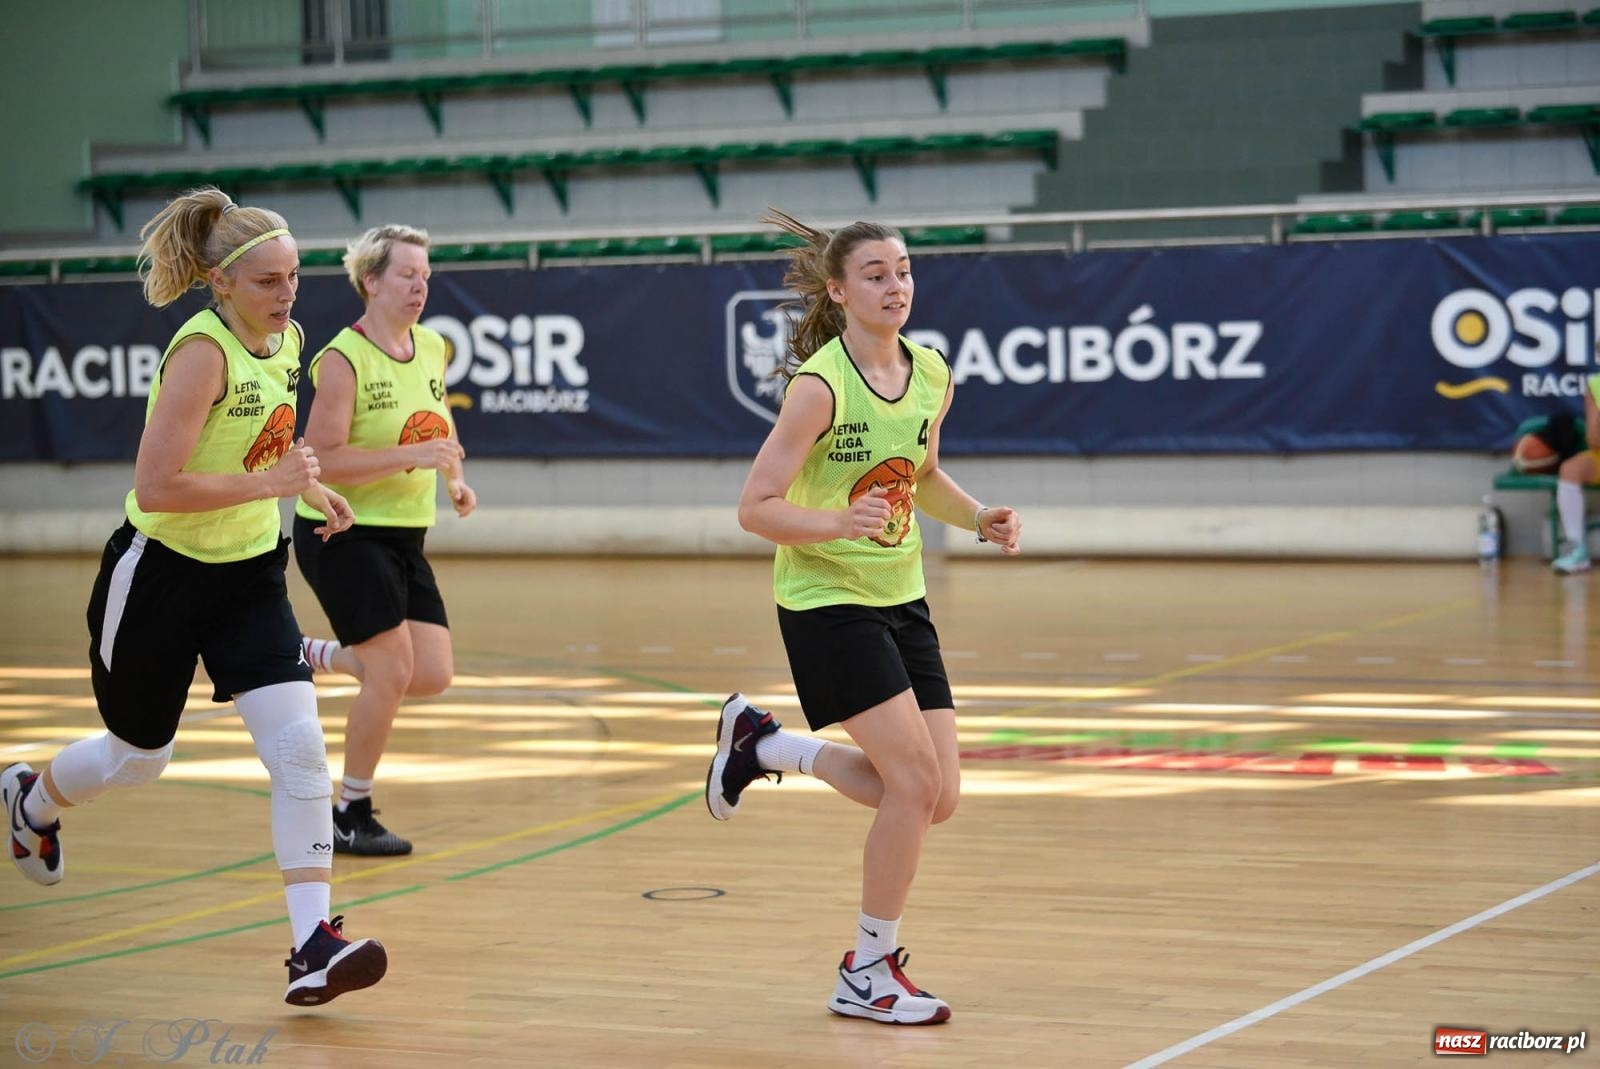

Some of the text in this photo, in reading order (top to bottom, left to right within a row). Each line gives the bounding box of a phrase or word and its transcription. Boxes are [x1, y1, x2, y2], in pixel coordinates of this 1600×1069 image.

[1430, 286, 1600, 369] OSi
[1, 344, 162, 399] RACIB
[1521, 372, 1590, 397] RACI
[239, 393, 261, 405] LIGA
[368, 401, 399, 411] KOBIET
[480, 387, 589, 413] RACIBÓRZ
[227, 406, 265, 417] KOBIET
[833, 422, 869, 436] LETNIA
[917, 418, 929, 450] 4
[835, 437, 863, 449] LIGA
[827, 450, 872, 462] KOBIET
